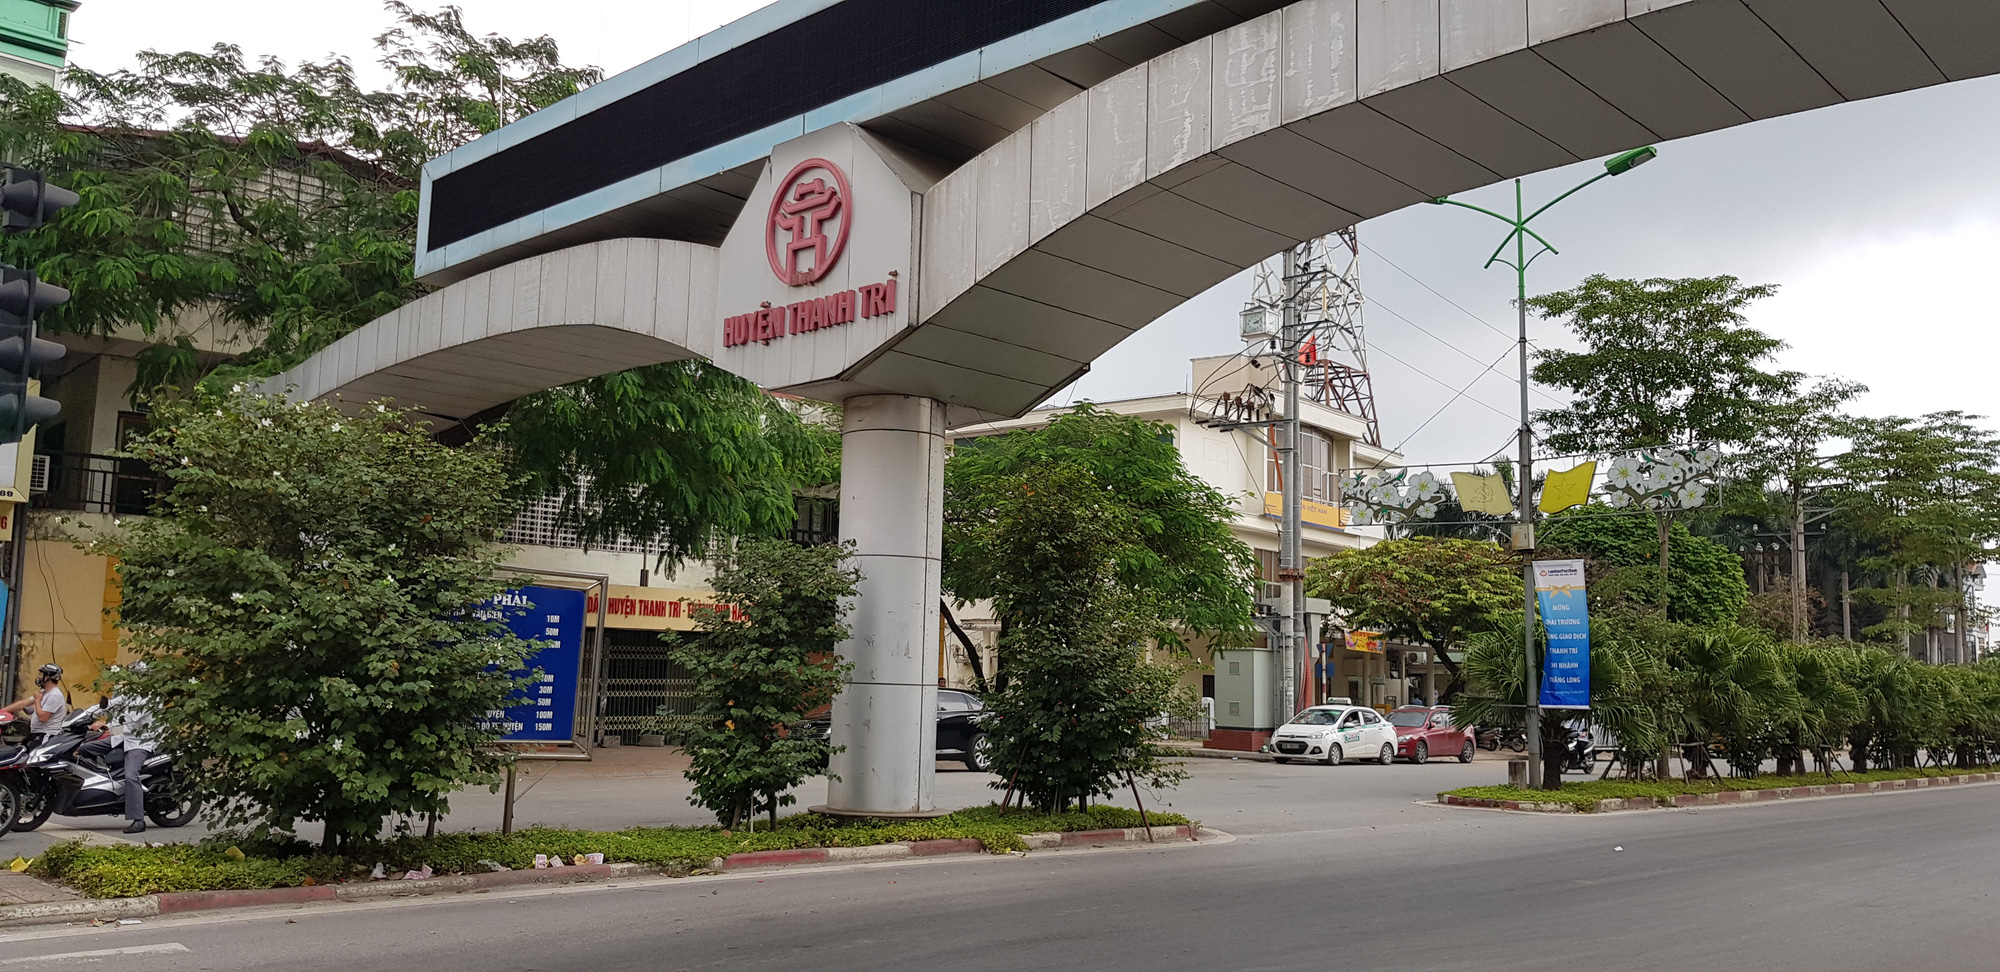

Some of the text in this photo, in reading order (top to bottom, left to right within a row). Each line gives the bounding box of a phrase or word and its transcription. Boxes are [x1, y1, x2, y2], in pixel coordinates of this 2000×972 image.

[723, 301, 786, 348] HUYỆN
[786, 289, 856, 335] THANH
[858, 270, 898, 319] TRÌ
[493, 591, 528, 607] PHẢI
[607, 595, 637, 619] HUYỆN
[638, 599, 667, 617] THANH
[547, 614, 560, 623] 10M
[546, 627, 559, 636] 50M
[1573, 633, 1587, 642] DỊCH
[1566, 676, 1581, 684] LONG
[539, 686, 553, 694] 30M
[537, 698, 552, 706] 50M
[536, 711, 553, 719] 100M
[535, 723, 552, 731] 150M
